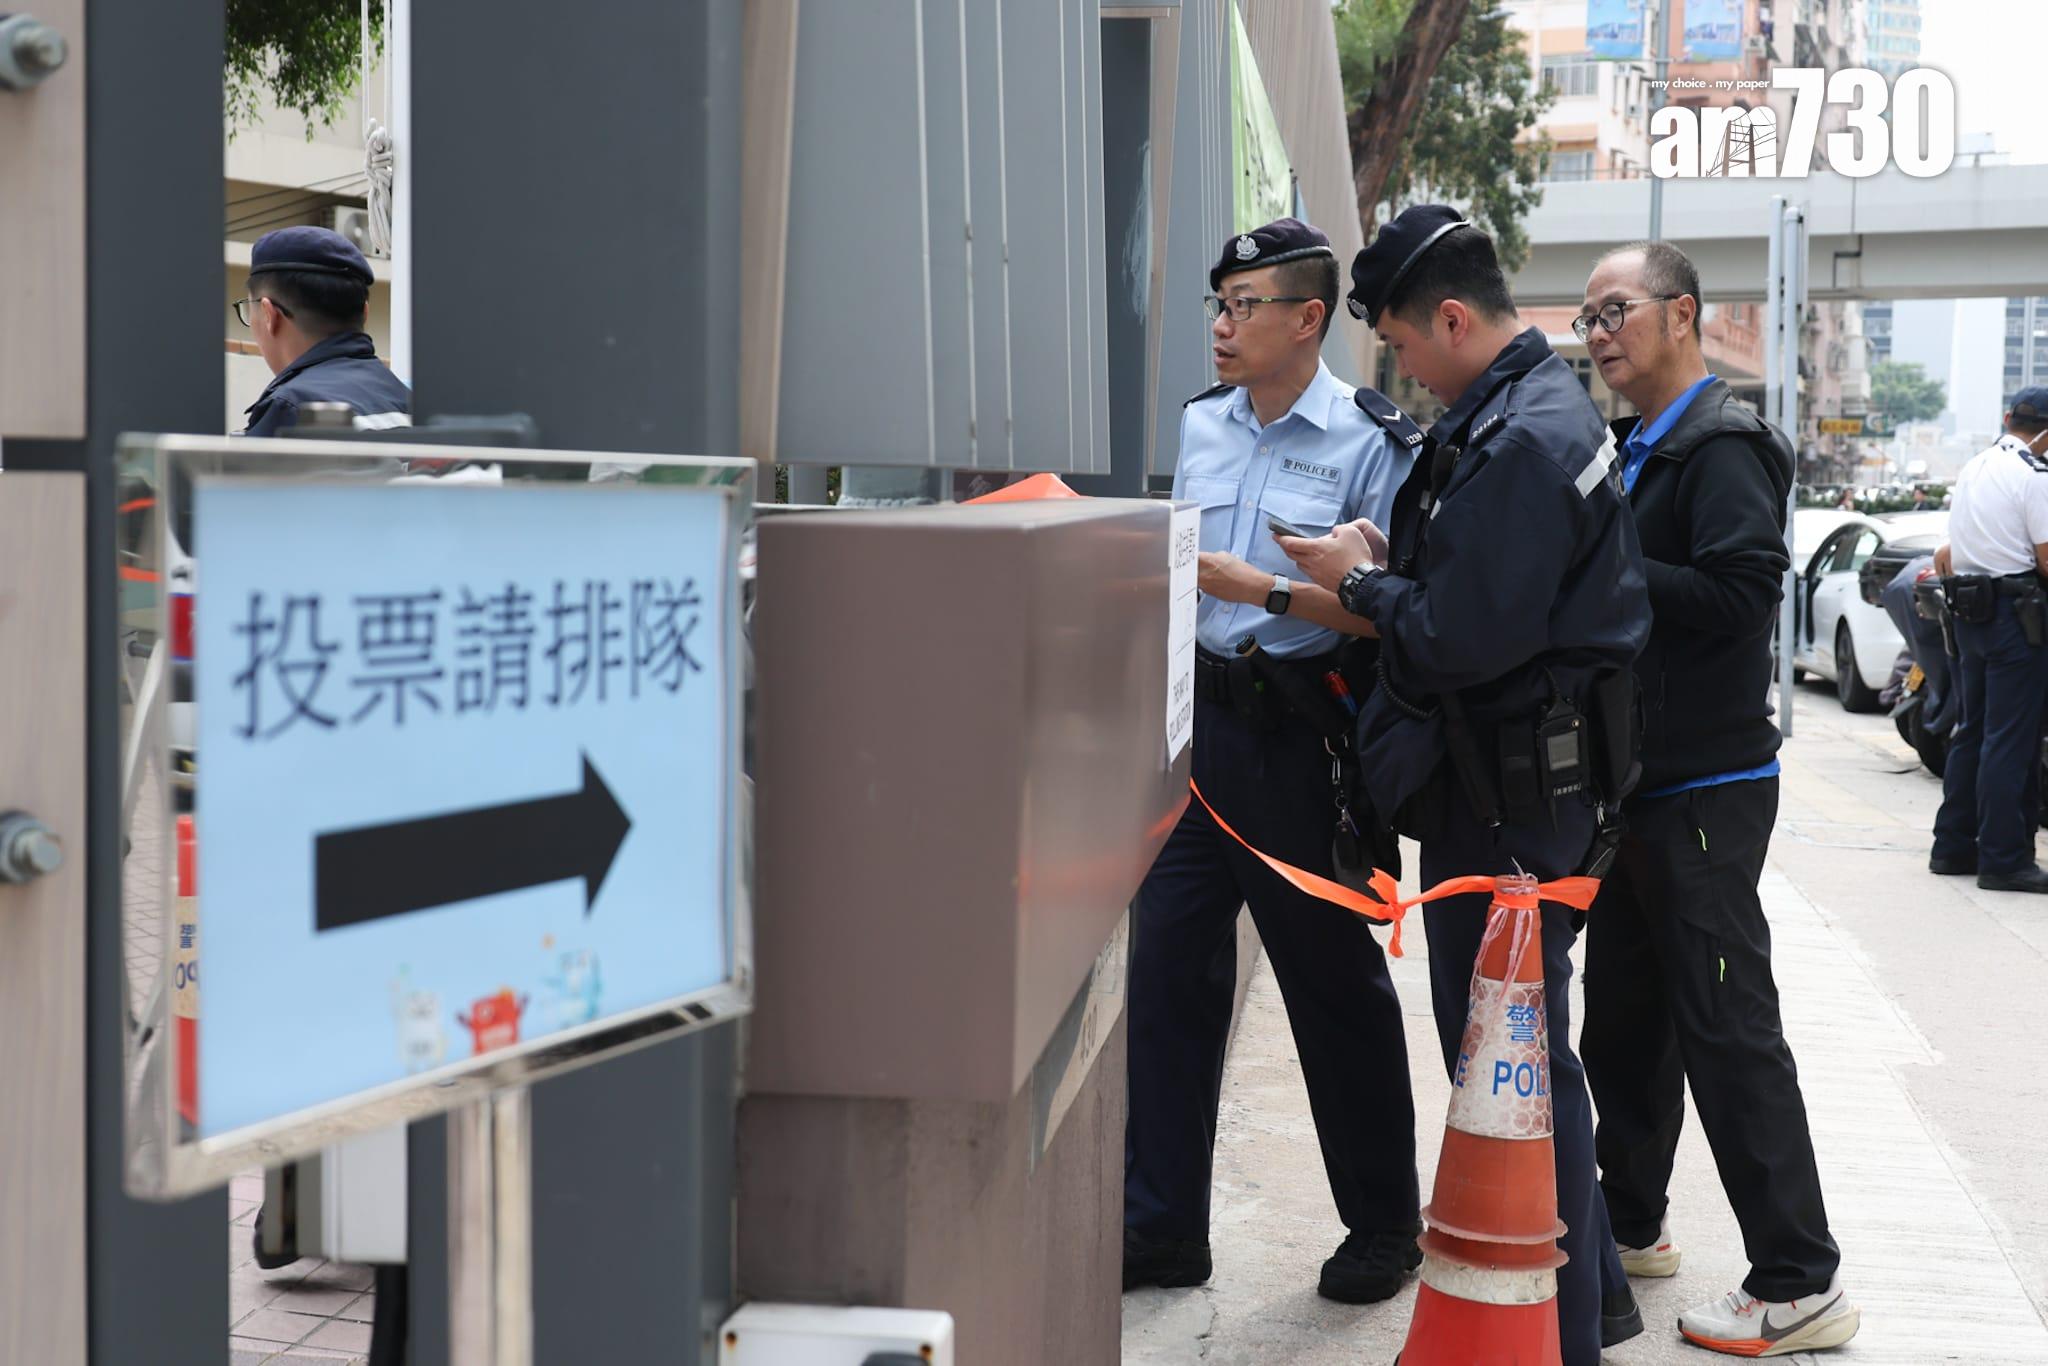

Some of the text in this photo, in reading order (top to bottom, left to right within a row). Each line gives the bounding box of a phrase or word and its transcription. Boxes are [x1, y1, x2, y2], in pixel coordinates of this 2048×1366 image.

[1293, 461, 1328, 477] POLICE
[231, 577, 705, 742] 投票請排隊
[1506, 1003, 1538, 1042] 警
